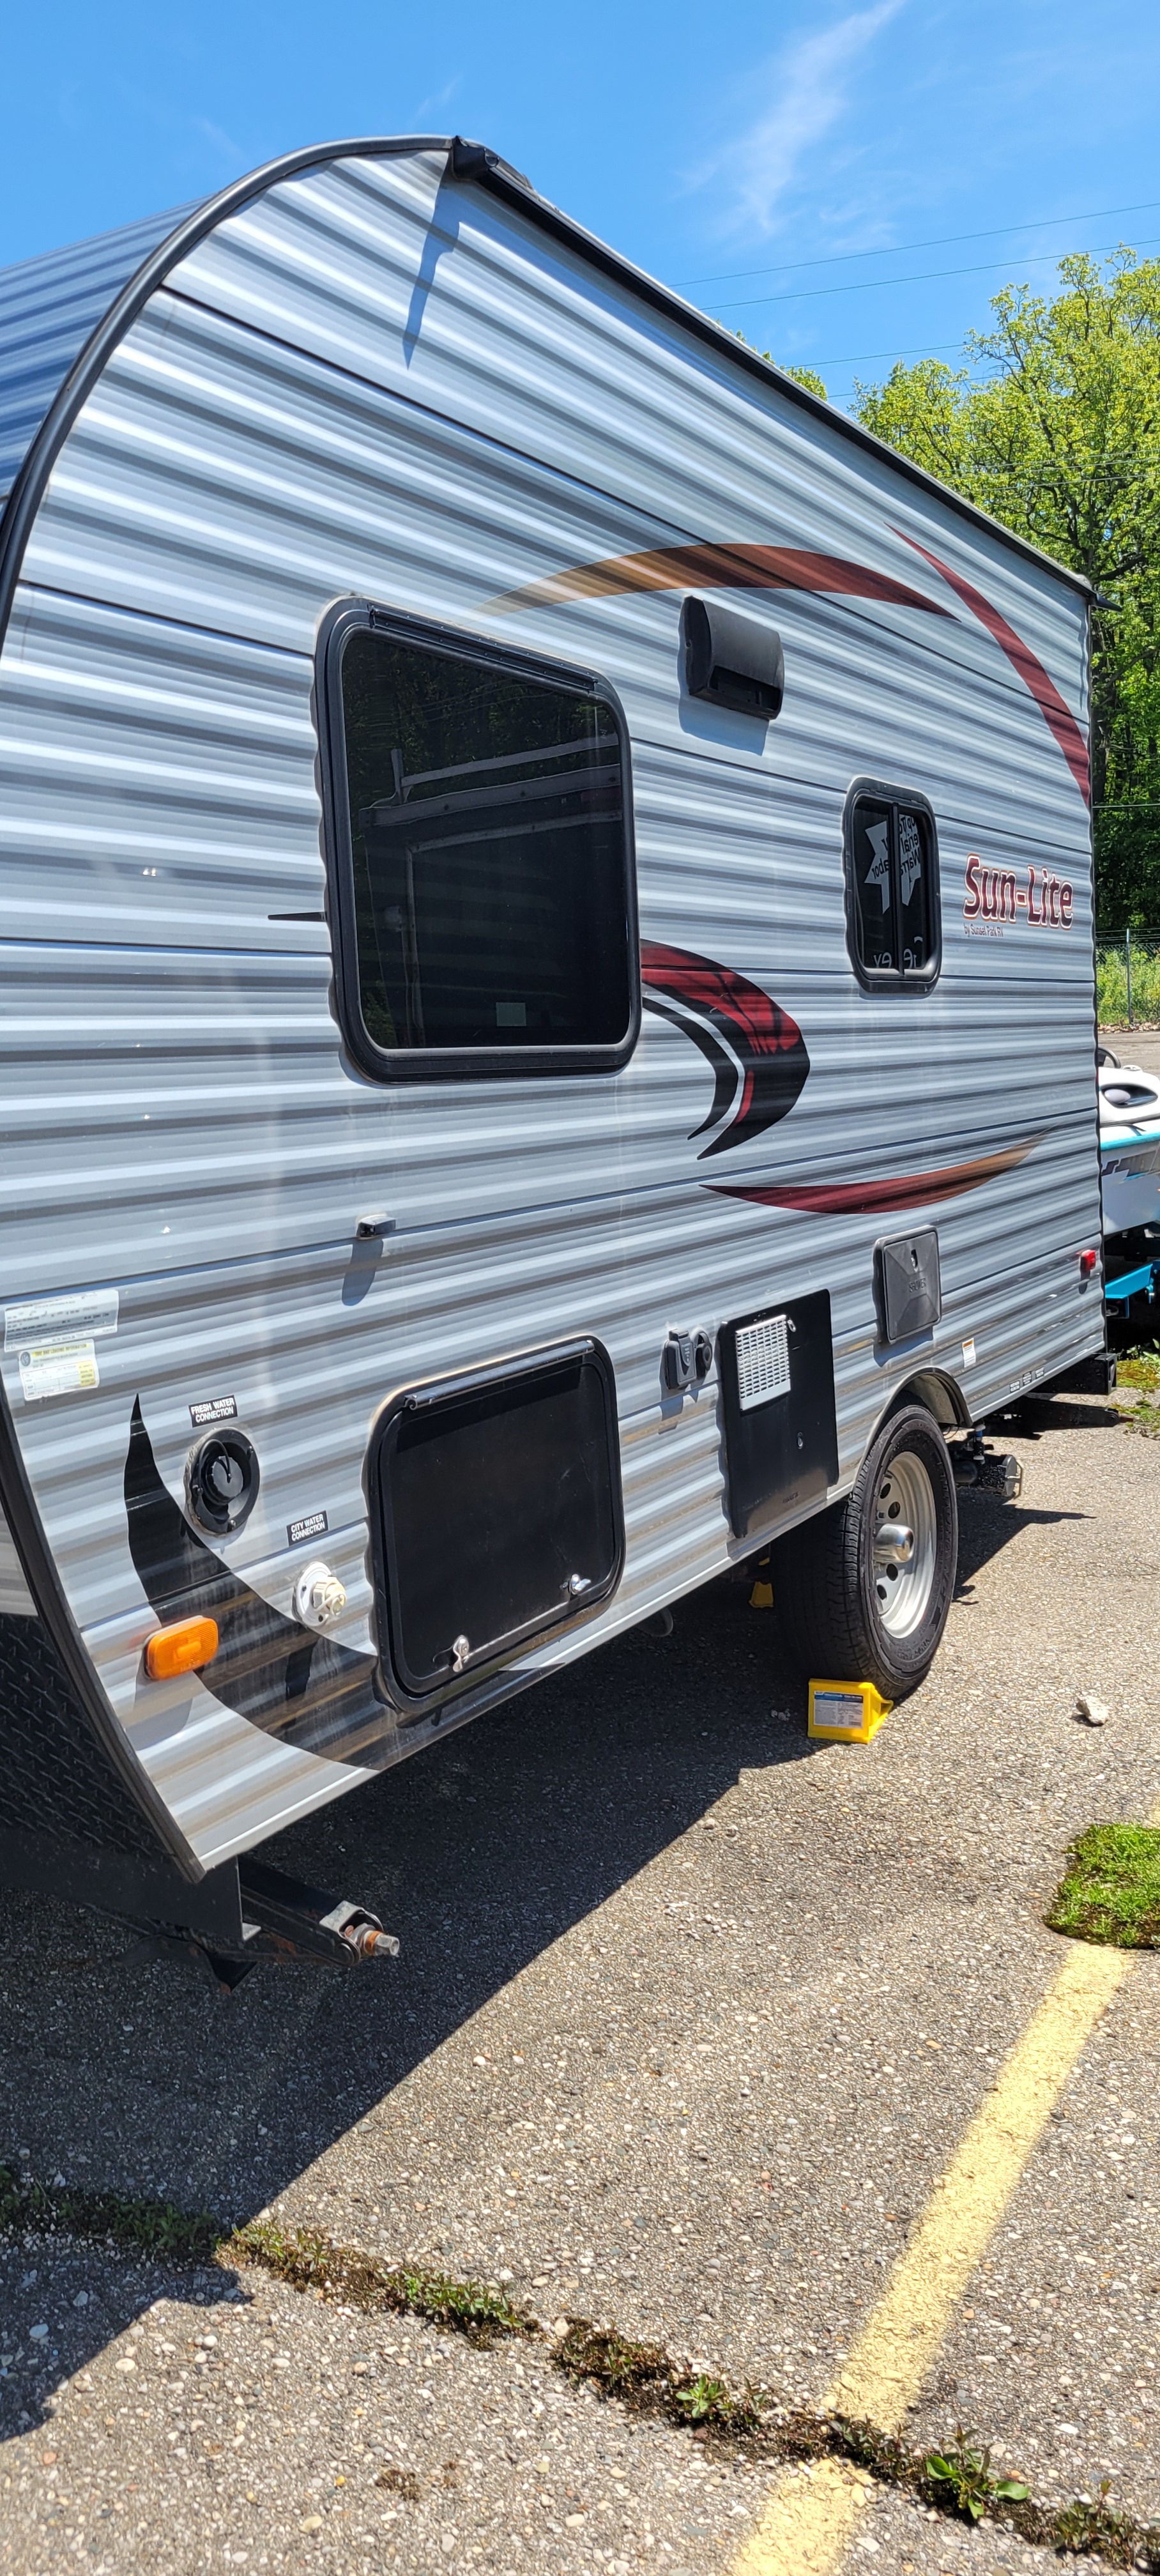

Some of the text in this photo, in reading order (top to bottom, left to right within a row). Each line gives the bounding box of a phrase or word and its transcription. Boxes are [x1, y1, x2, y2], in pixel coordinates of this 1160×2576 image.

[963, 853, 1074, 931] Sun-Lite
[190, 1397, 235, 1416] FRESH WATER
[195, 1406, 234, 1423] CONNECTION
[291, 1514, 324, 1533] CITY WATER
[291, 1521, 325, 1542] CONNECTION
